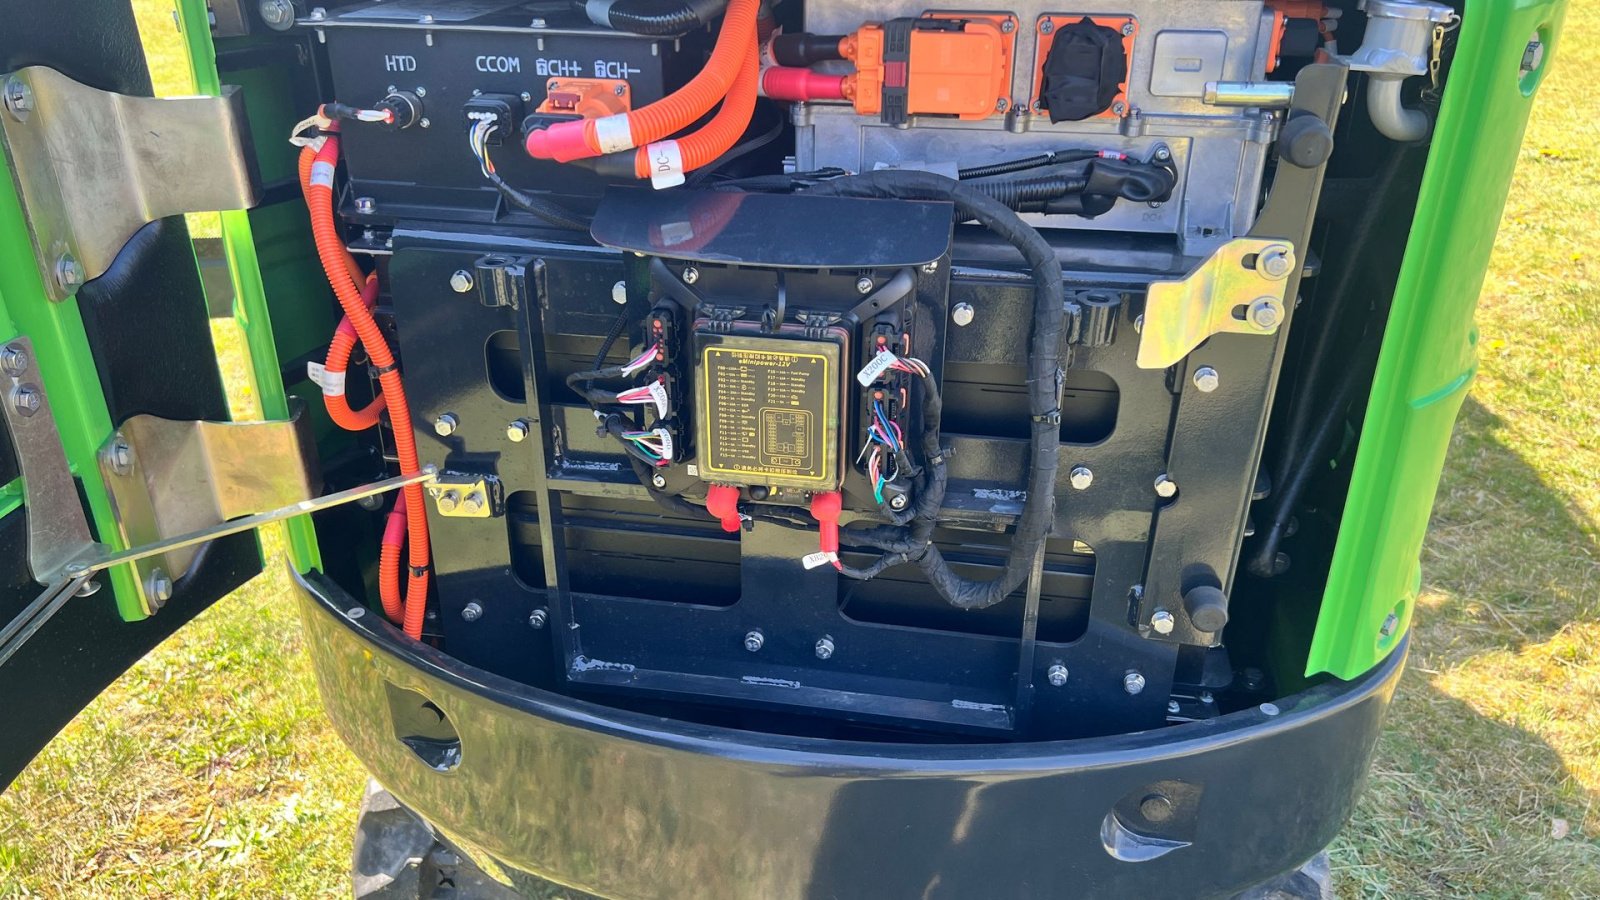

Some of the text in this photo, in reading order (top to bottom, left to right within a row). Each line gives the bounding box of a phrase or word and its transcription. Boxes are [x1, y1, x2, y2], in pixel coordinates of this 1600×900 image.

[385, 55, 416, 72] HTD
[476, 56, 521, 73] CCOM
[863, 354, 888, 376] X200C
